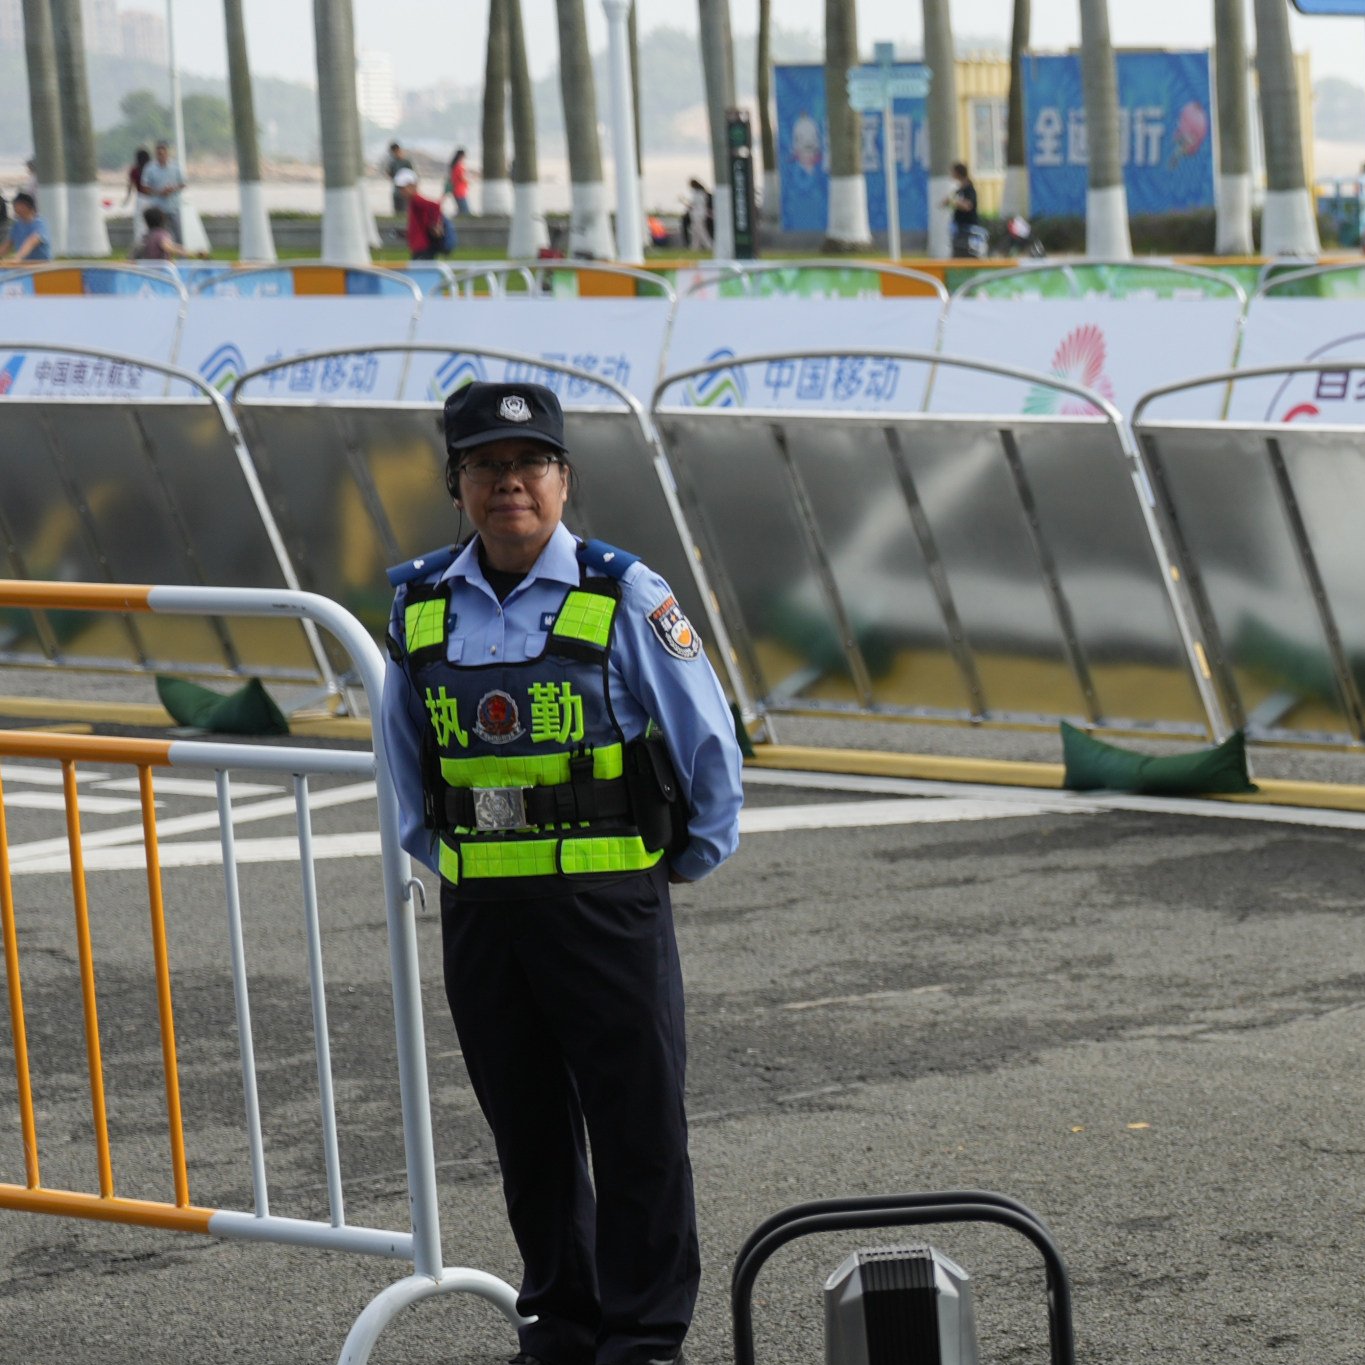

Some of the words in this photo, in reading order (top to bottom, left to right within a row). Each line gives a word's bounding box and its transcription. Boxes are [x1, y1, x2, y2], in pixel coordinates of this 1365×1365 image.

[33, 356, 144, 391] 中国南方航空
[262, 349, 380, 393] 中国移动
[764, 356, 898, 401] 中国移动
